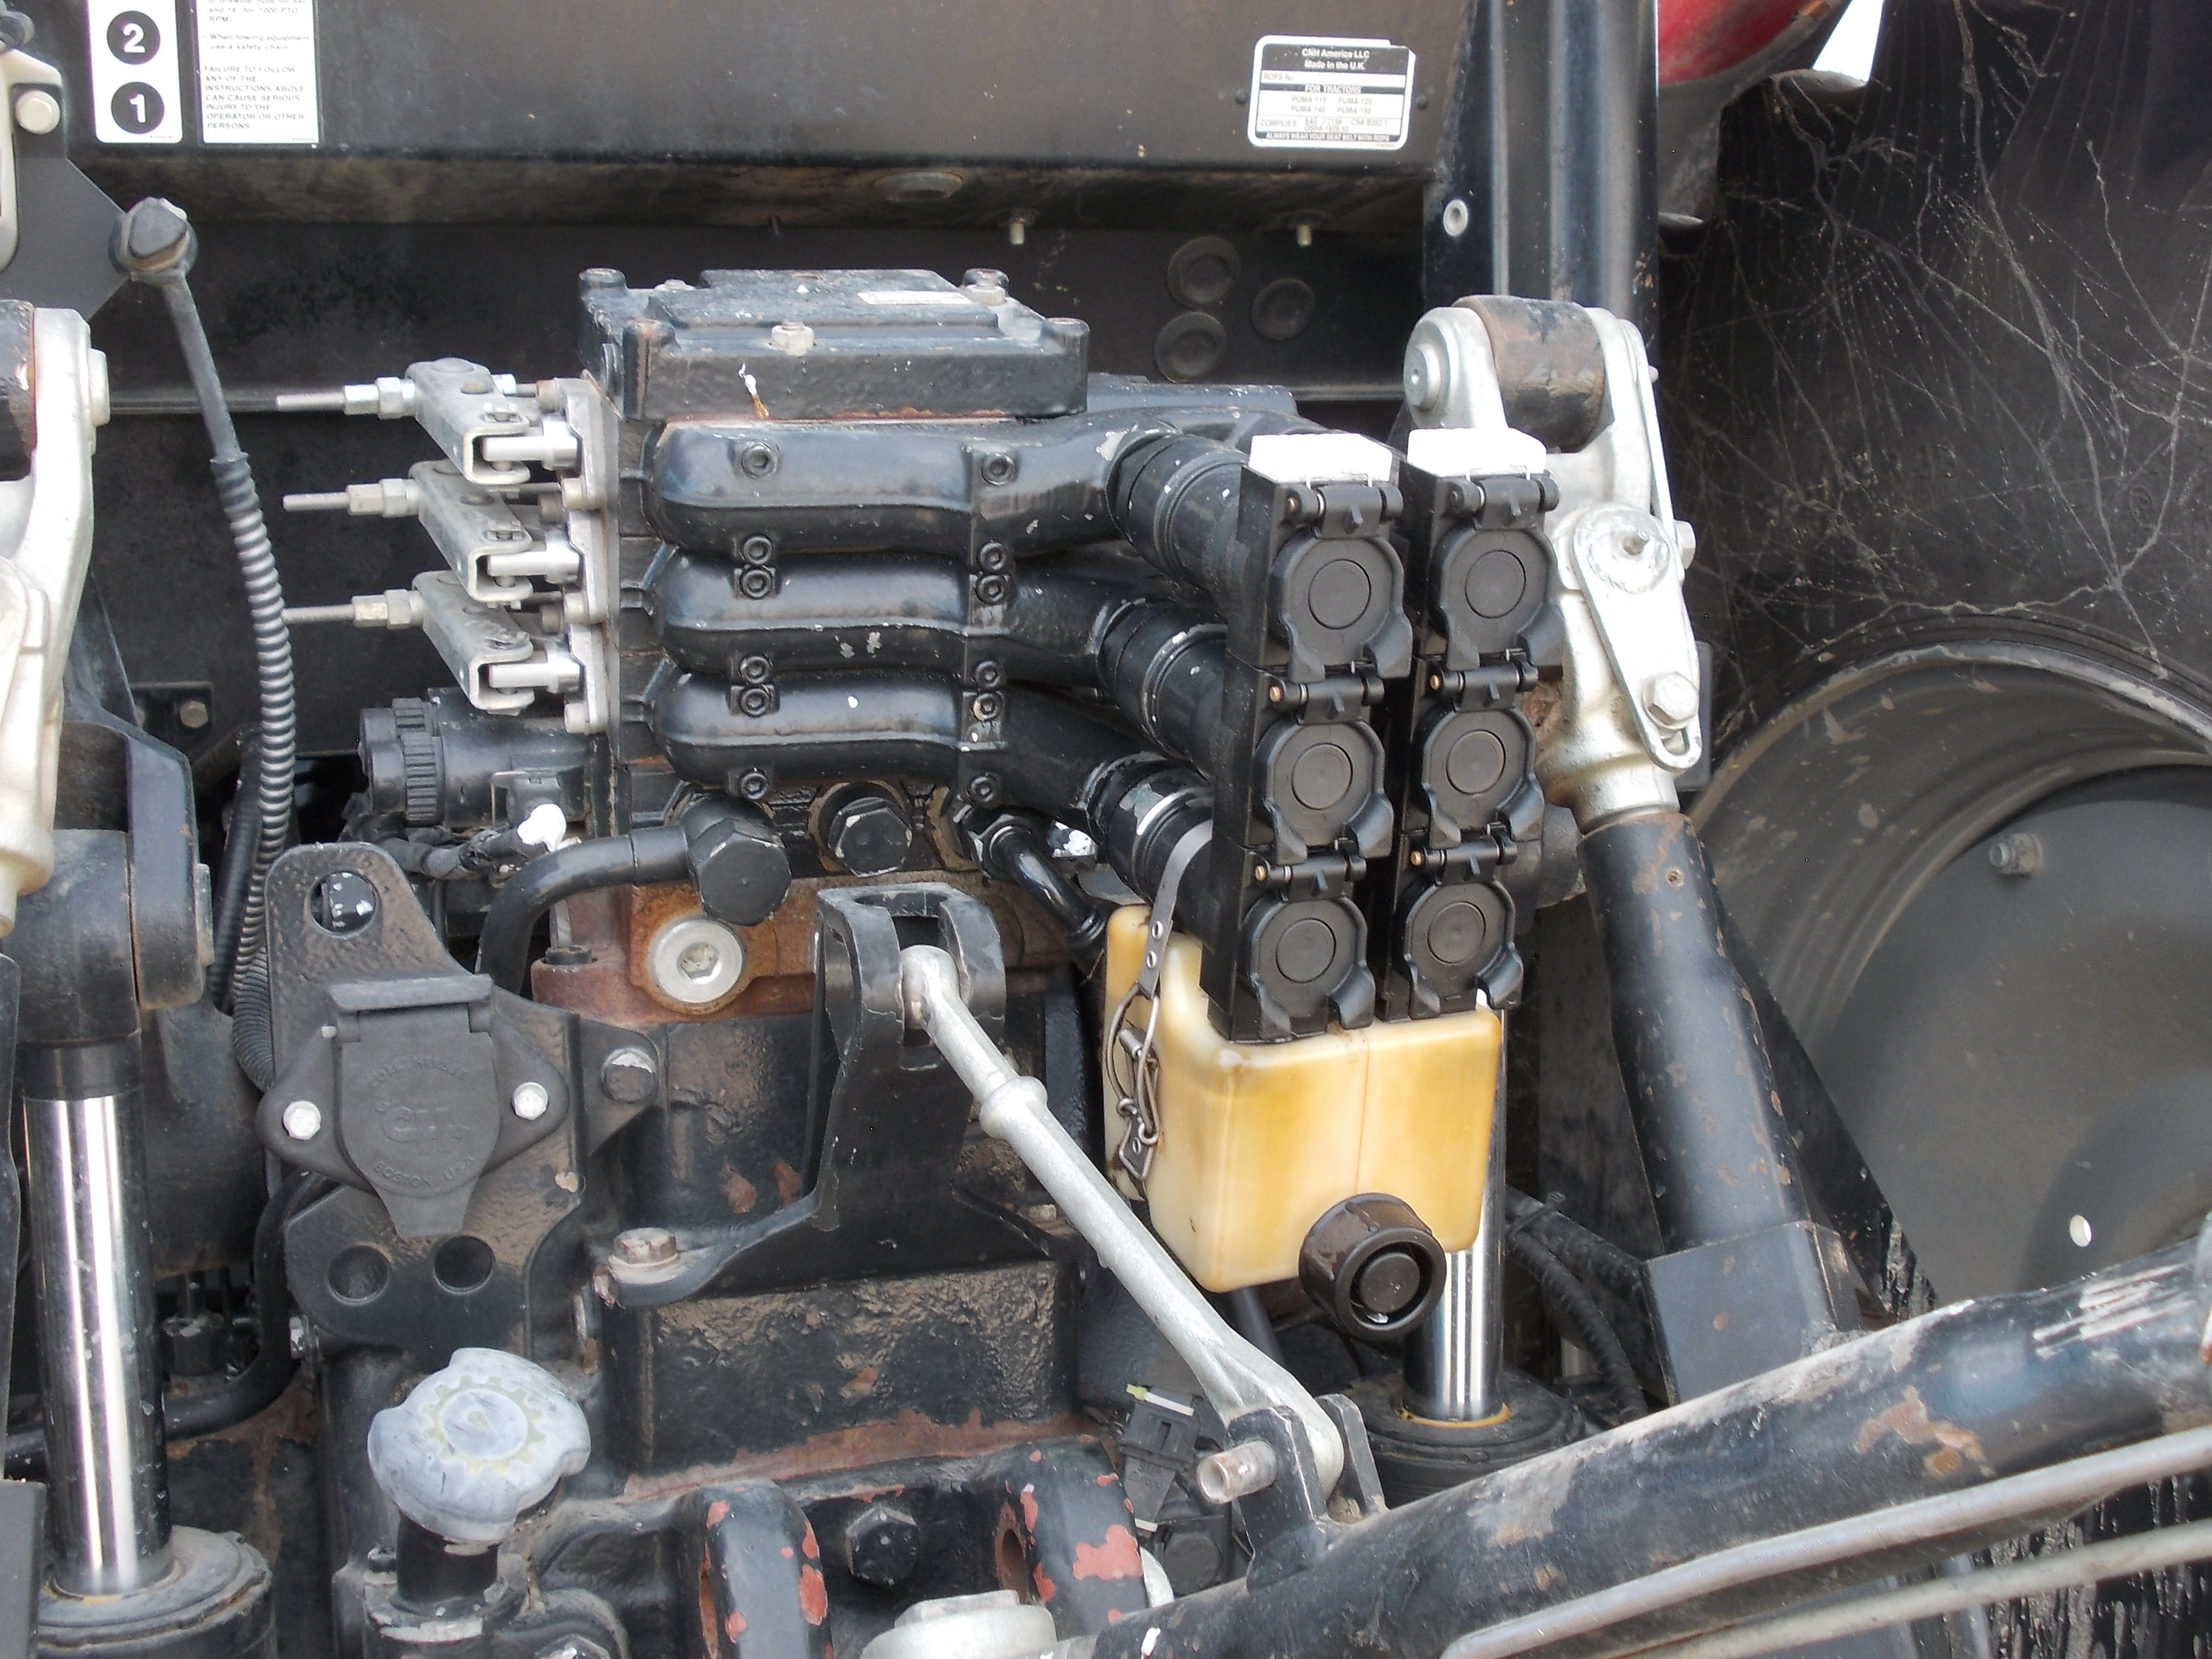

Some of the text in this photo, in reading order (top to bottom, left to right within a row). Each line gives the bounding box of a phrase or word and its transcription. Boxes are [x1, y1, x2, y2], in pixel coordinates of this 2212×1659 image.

[122, 22, 146, 53] 2
[1302, 48, 1370, 58] CNH America LLC
[1304, 59, 1326, 69] Made
[1327, 60, 1335, 69] in
[1336, 61, 1349, 69] the
[1304, 84, 1361, 93] FOR TRACTORS
[130, 93, 146, 122] 1
